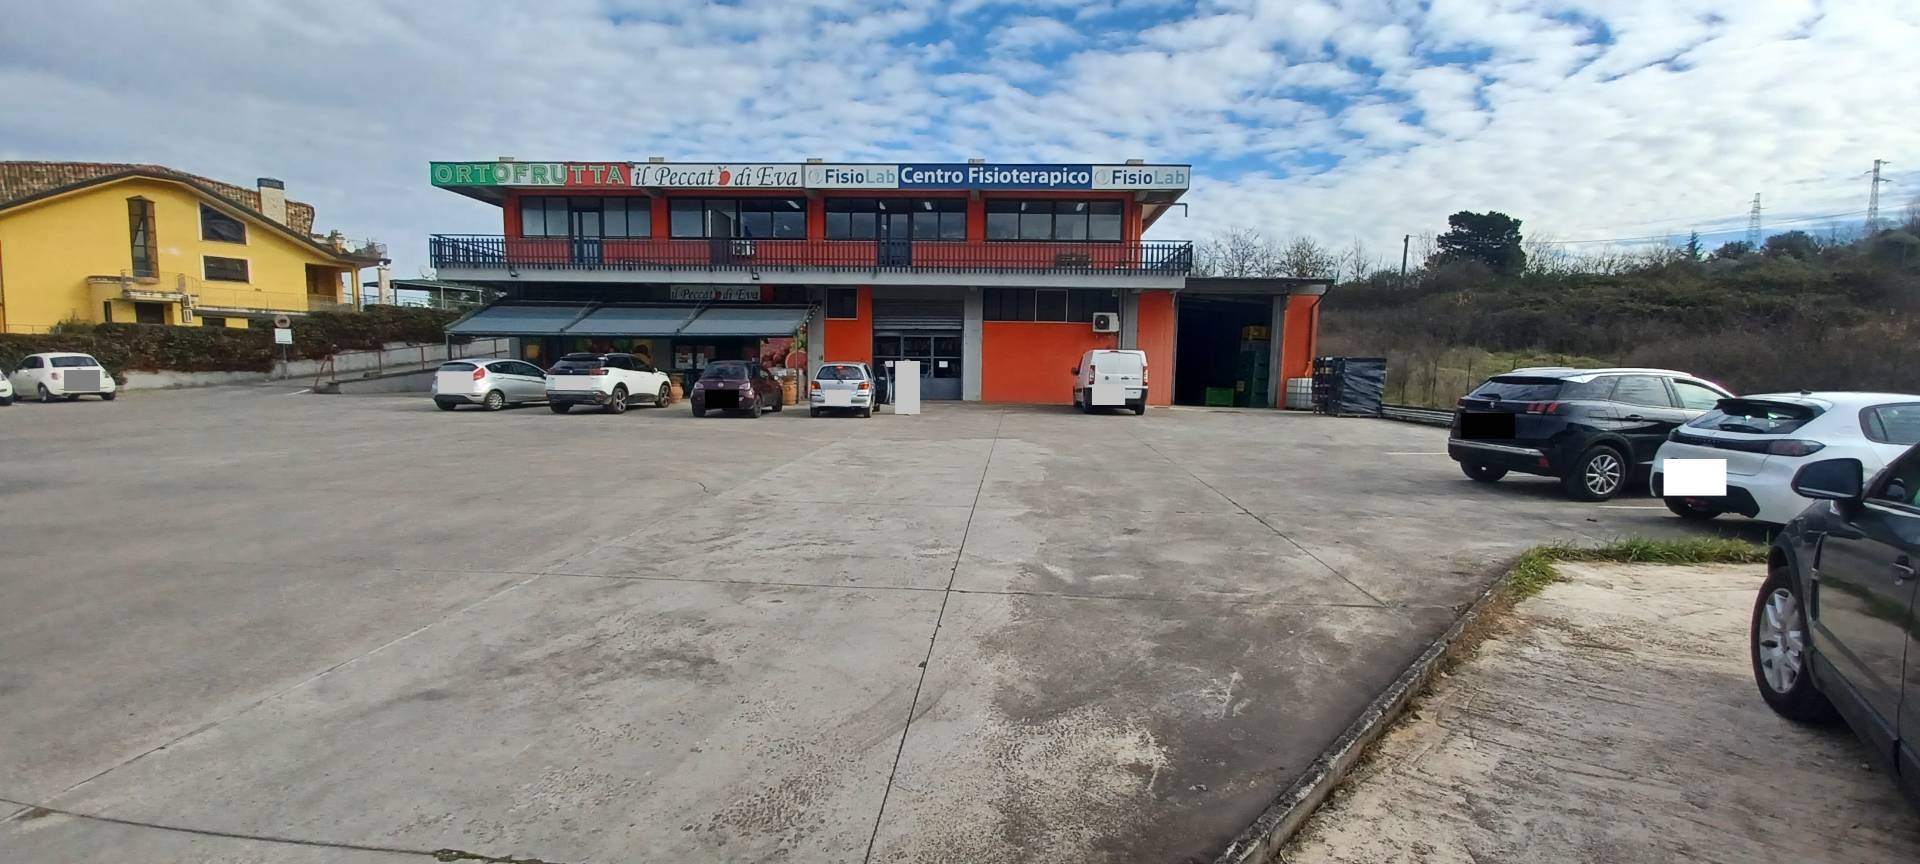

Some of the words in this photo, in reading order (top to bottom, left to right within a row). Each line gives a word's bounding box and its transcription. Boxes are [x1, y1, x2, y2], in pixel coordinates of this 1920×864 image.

[434, 164, 626, 185] ORTOFRUTTA
[635, 166, 649, 186] il
[734, 166, 751, 186] di
[756, 166, 798, 186] Eva
[825, 168, 896, 184] FisioLab
[900, 167, 963, 184] Centro
[968, 167, 1090, 187] Fisioterapico
[1112, 169, 1186, 185] FisioLab
